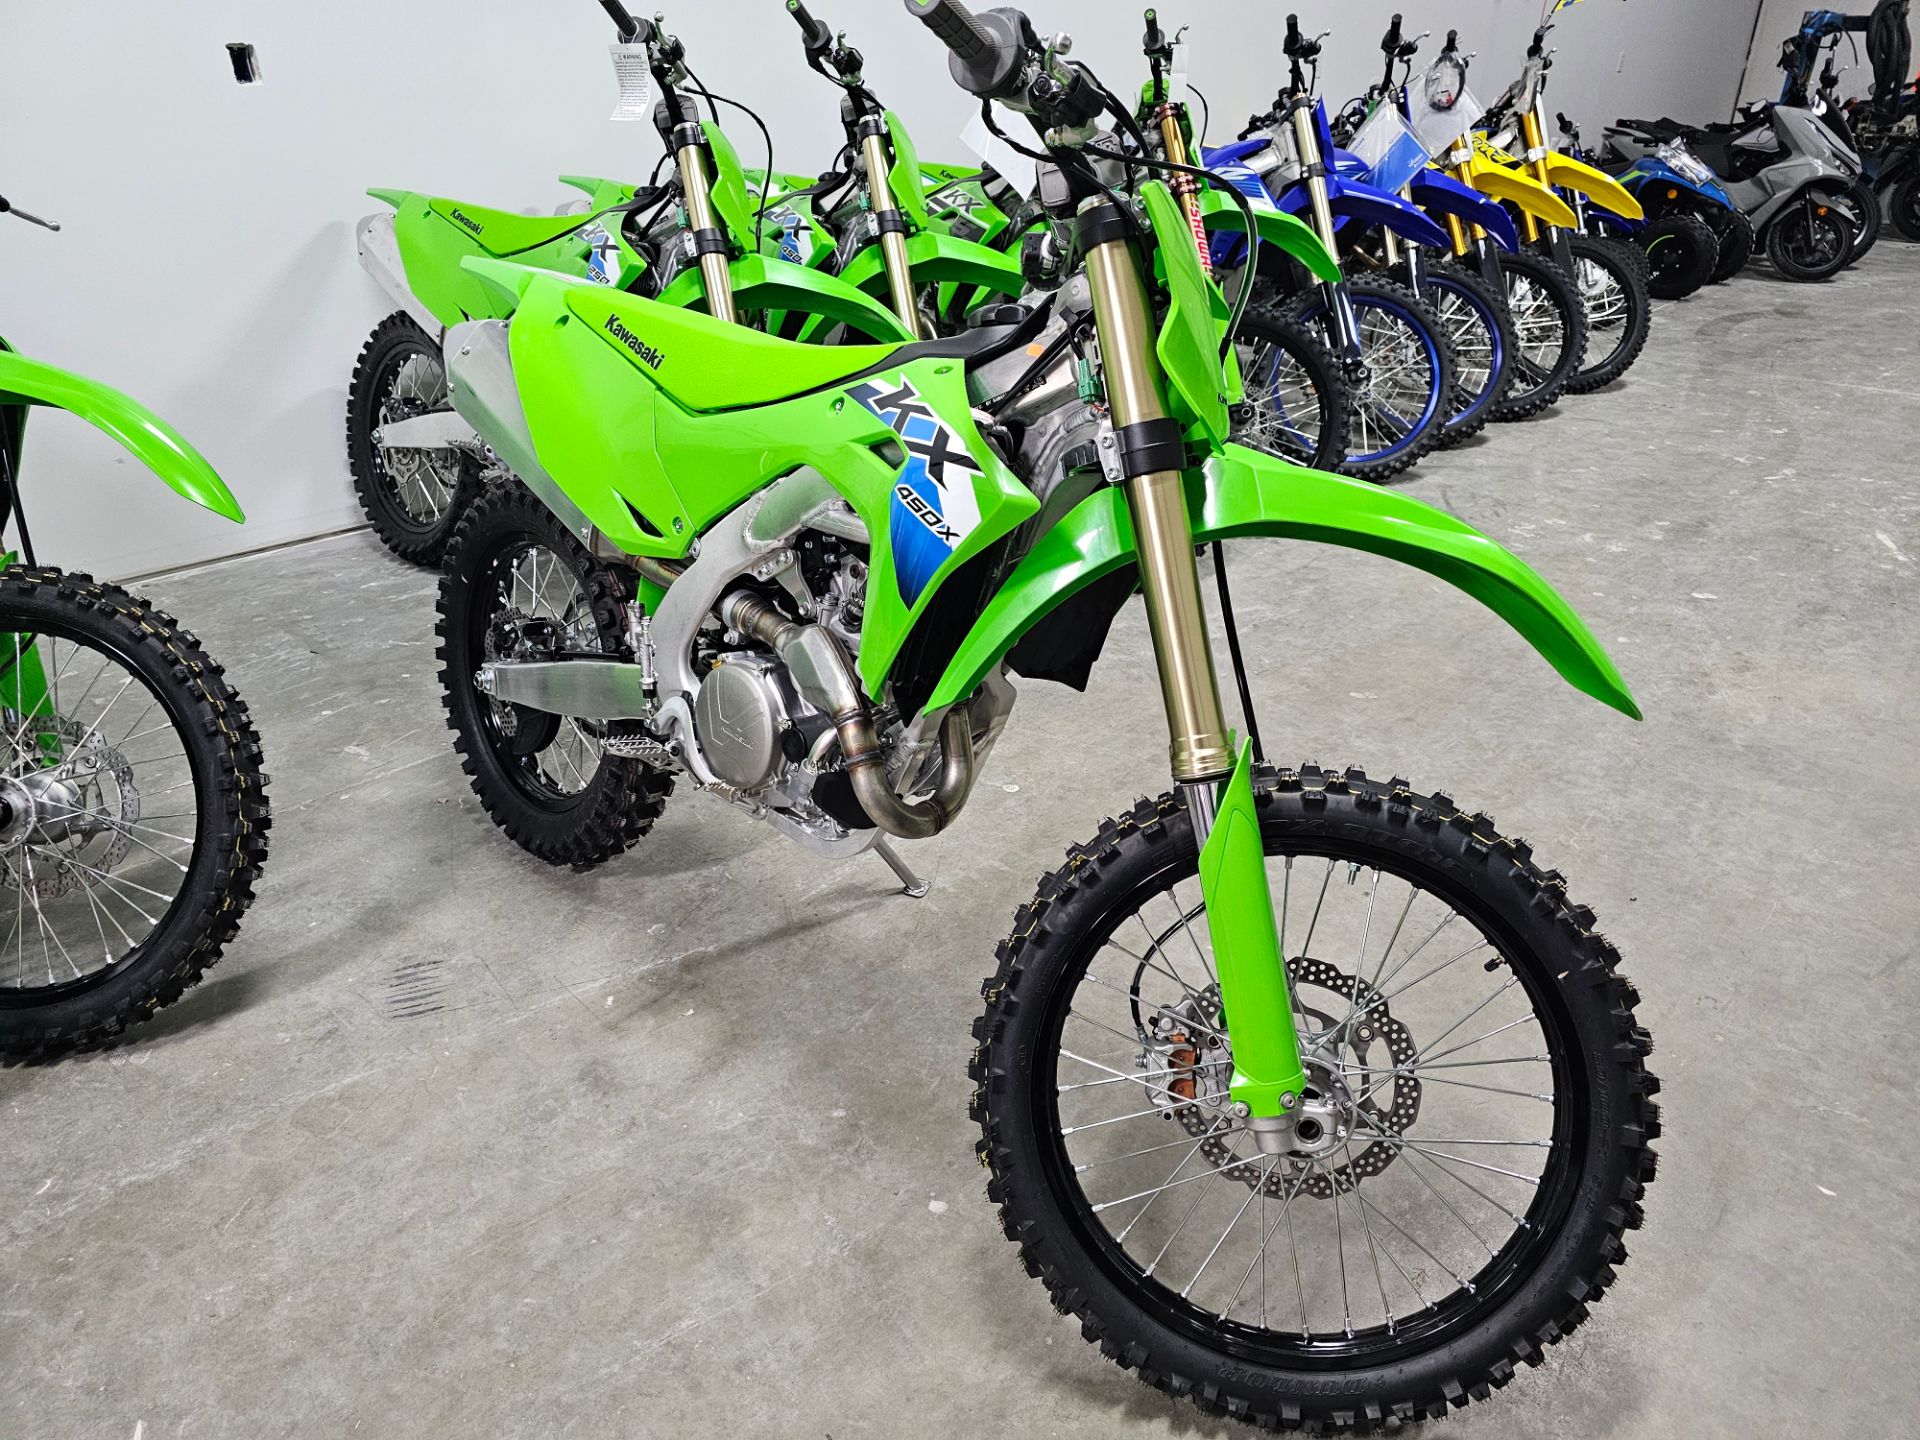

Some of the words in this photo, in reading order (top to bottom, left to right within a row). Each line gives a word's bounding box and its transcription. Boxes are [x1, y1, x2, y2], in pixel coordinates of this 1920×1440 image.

[450, 207, 484, 235] Kawasaki
[943, 189, 984, 214] KX
[585, 222, 620, 263] KX
[773, 205, 813, 242] KX
[1190, 207, 1212, 267] SHOWA
[589, 265, 610, 284] 250
[604, 313, 665, 370] Kawasaki
[871, 379, 984, 491] KX
[896, 485, 961, 541] 450X
[1217, 1367, 1367, 1397] DUNLOP
